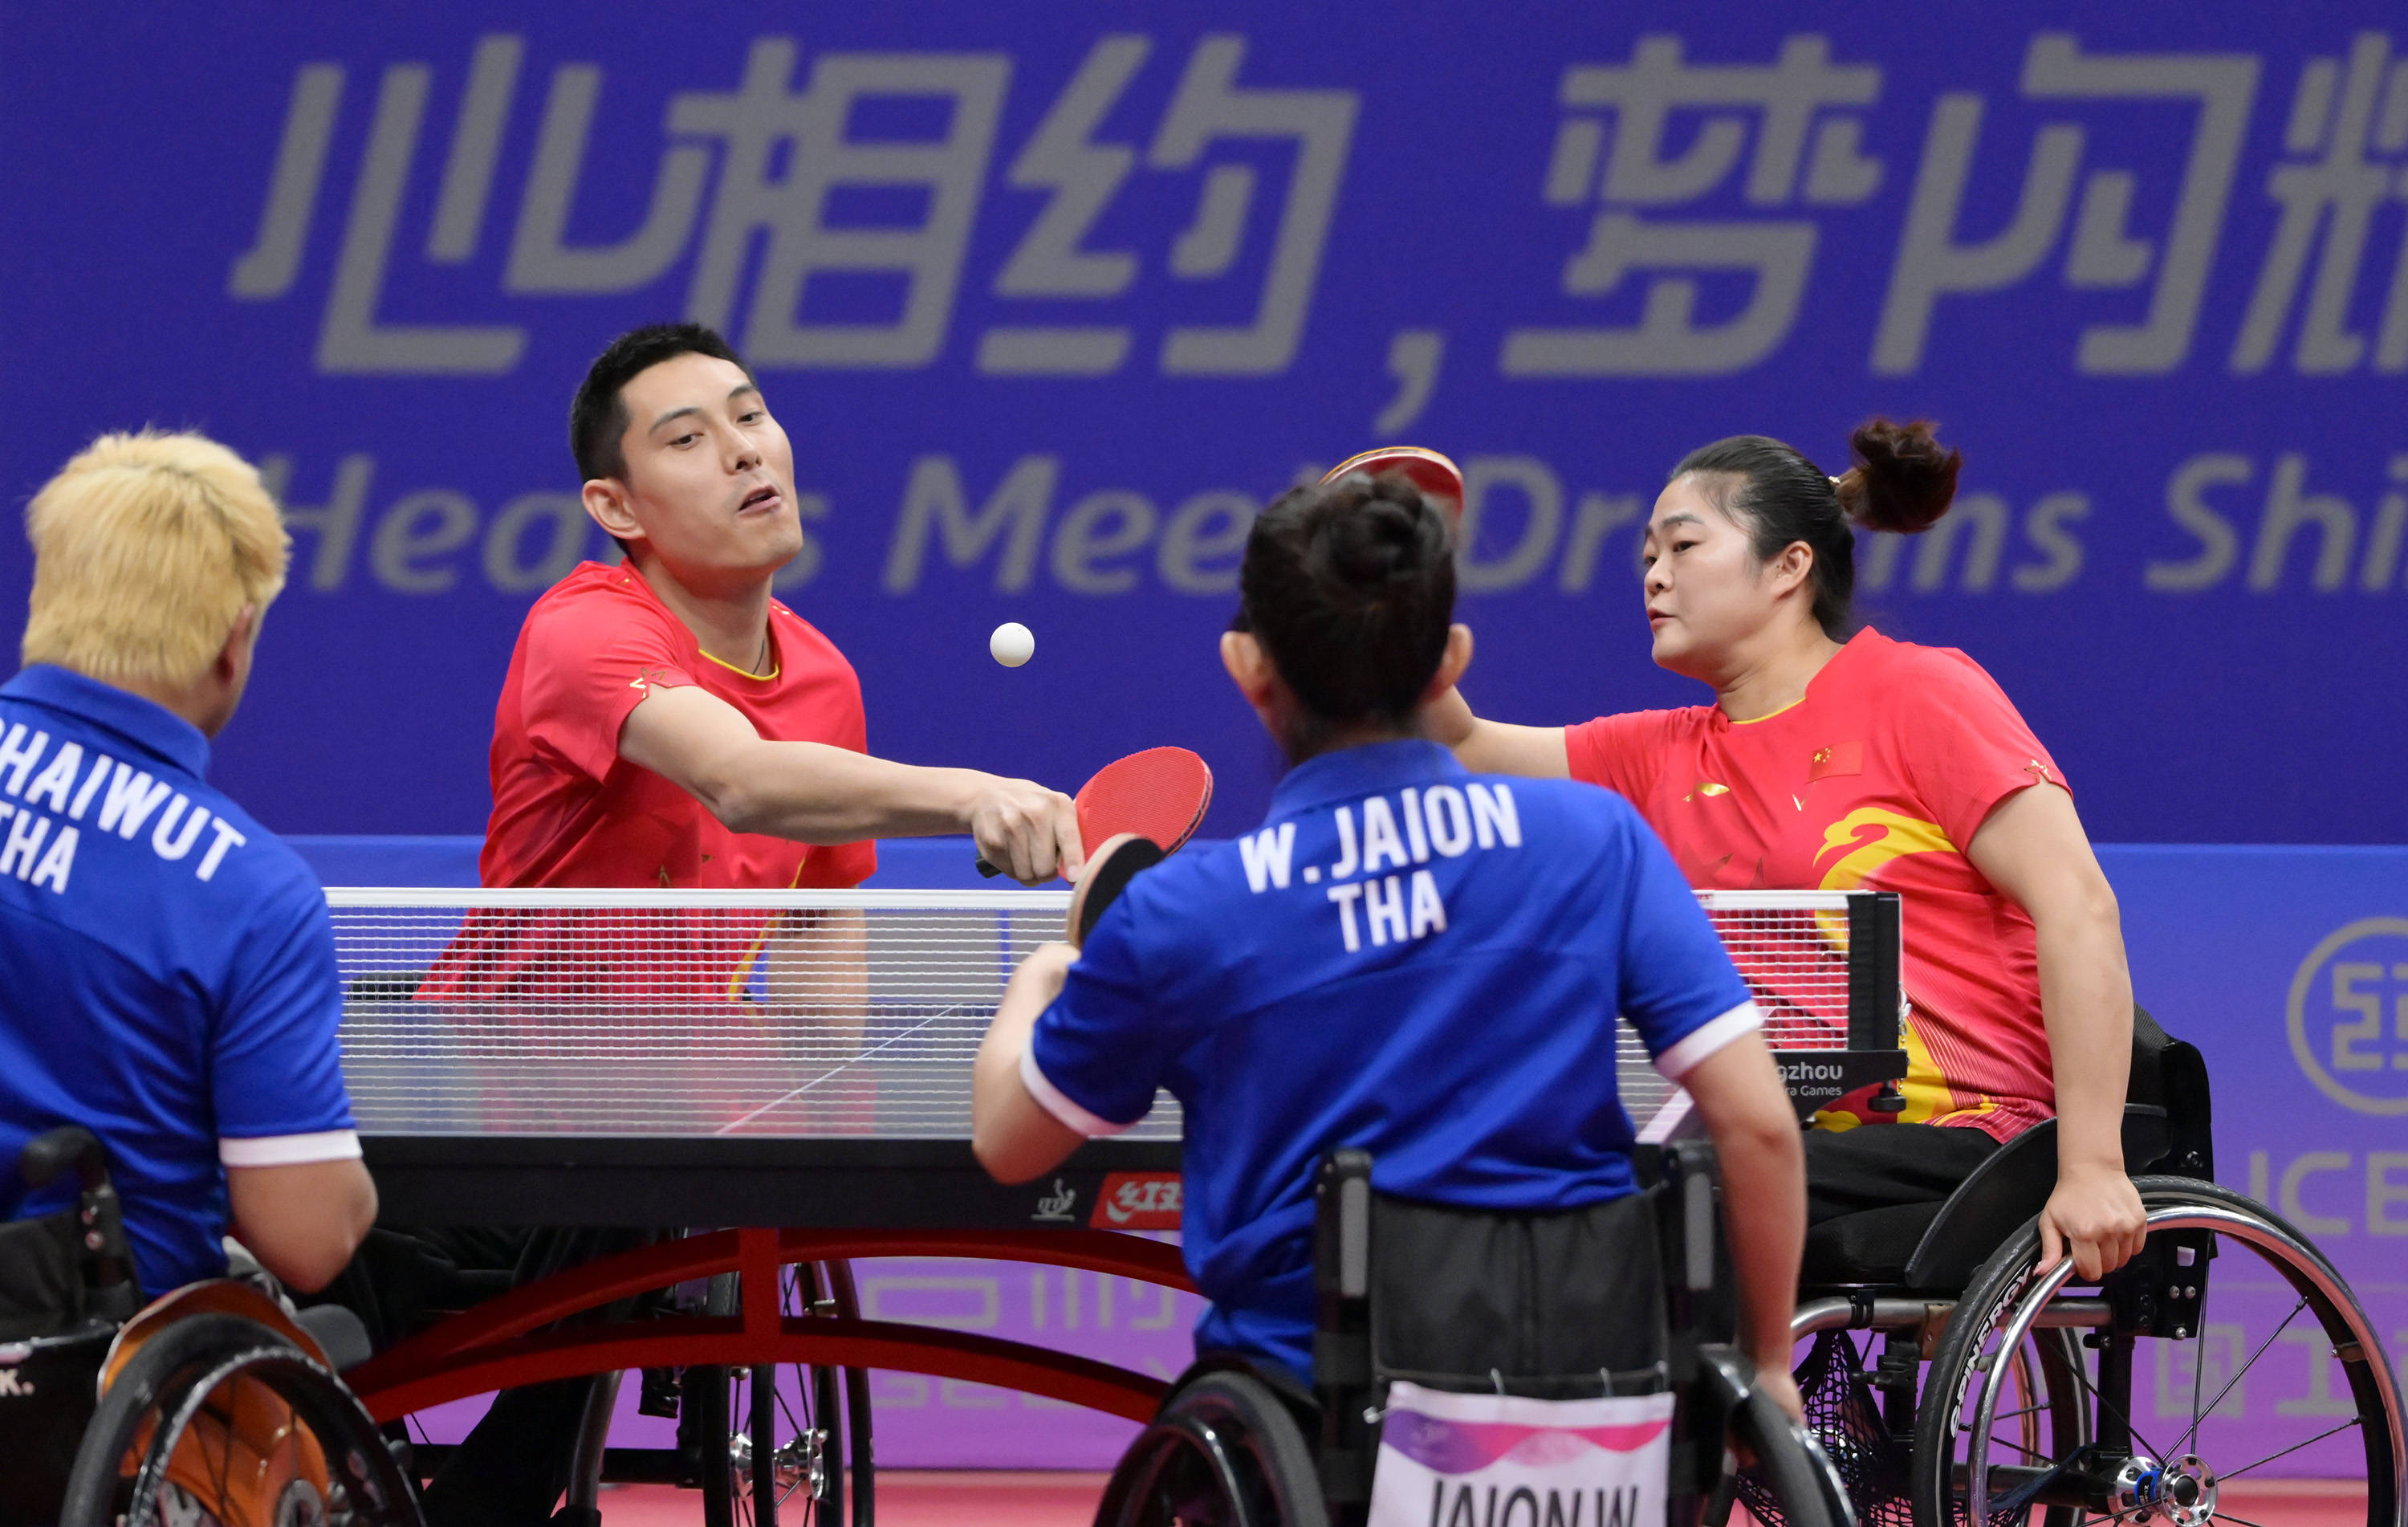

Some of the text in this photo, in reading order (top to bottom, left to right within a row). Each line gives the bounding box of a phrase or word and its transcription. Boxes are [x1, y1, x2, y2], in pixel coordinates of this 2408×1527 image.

[262, 451, 2408, 596] Hea Mee Drms Shi
[0, 717, 246, 882] HAIWUT
[1327, 869, 1447, 953] THA
[1800, 1085, 1843, 1097] Games
